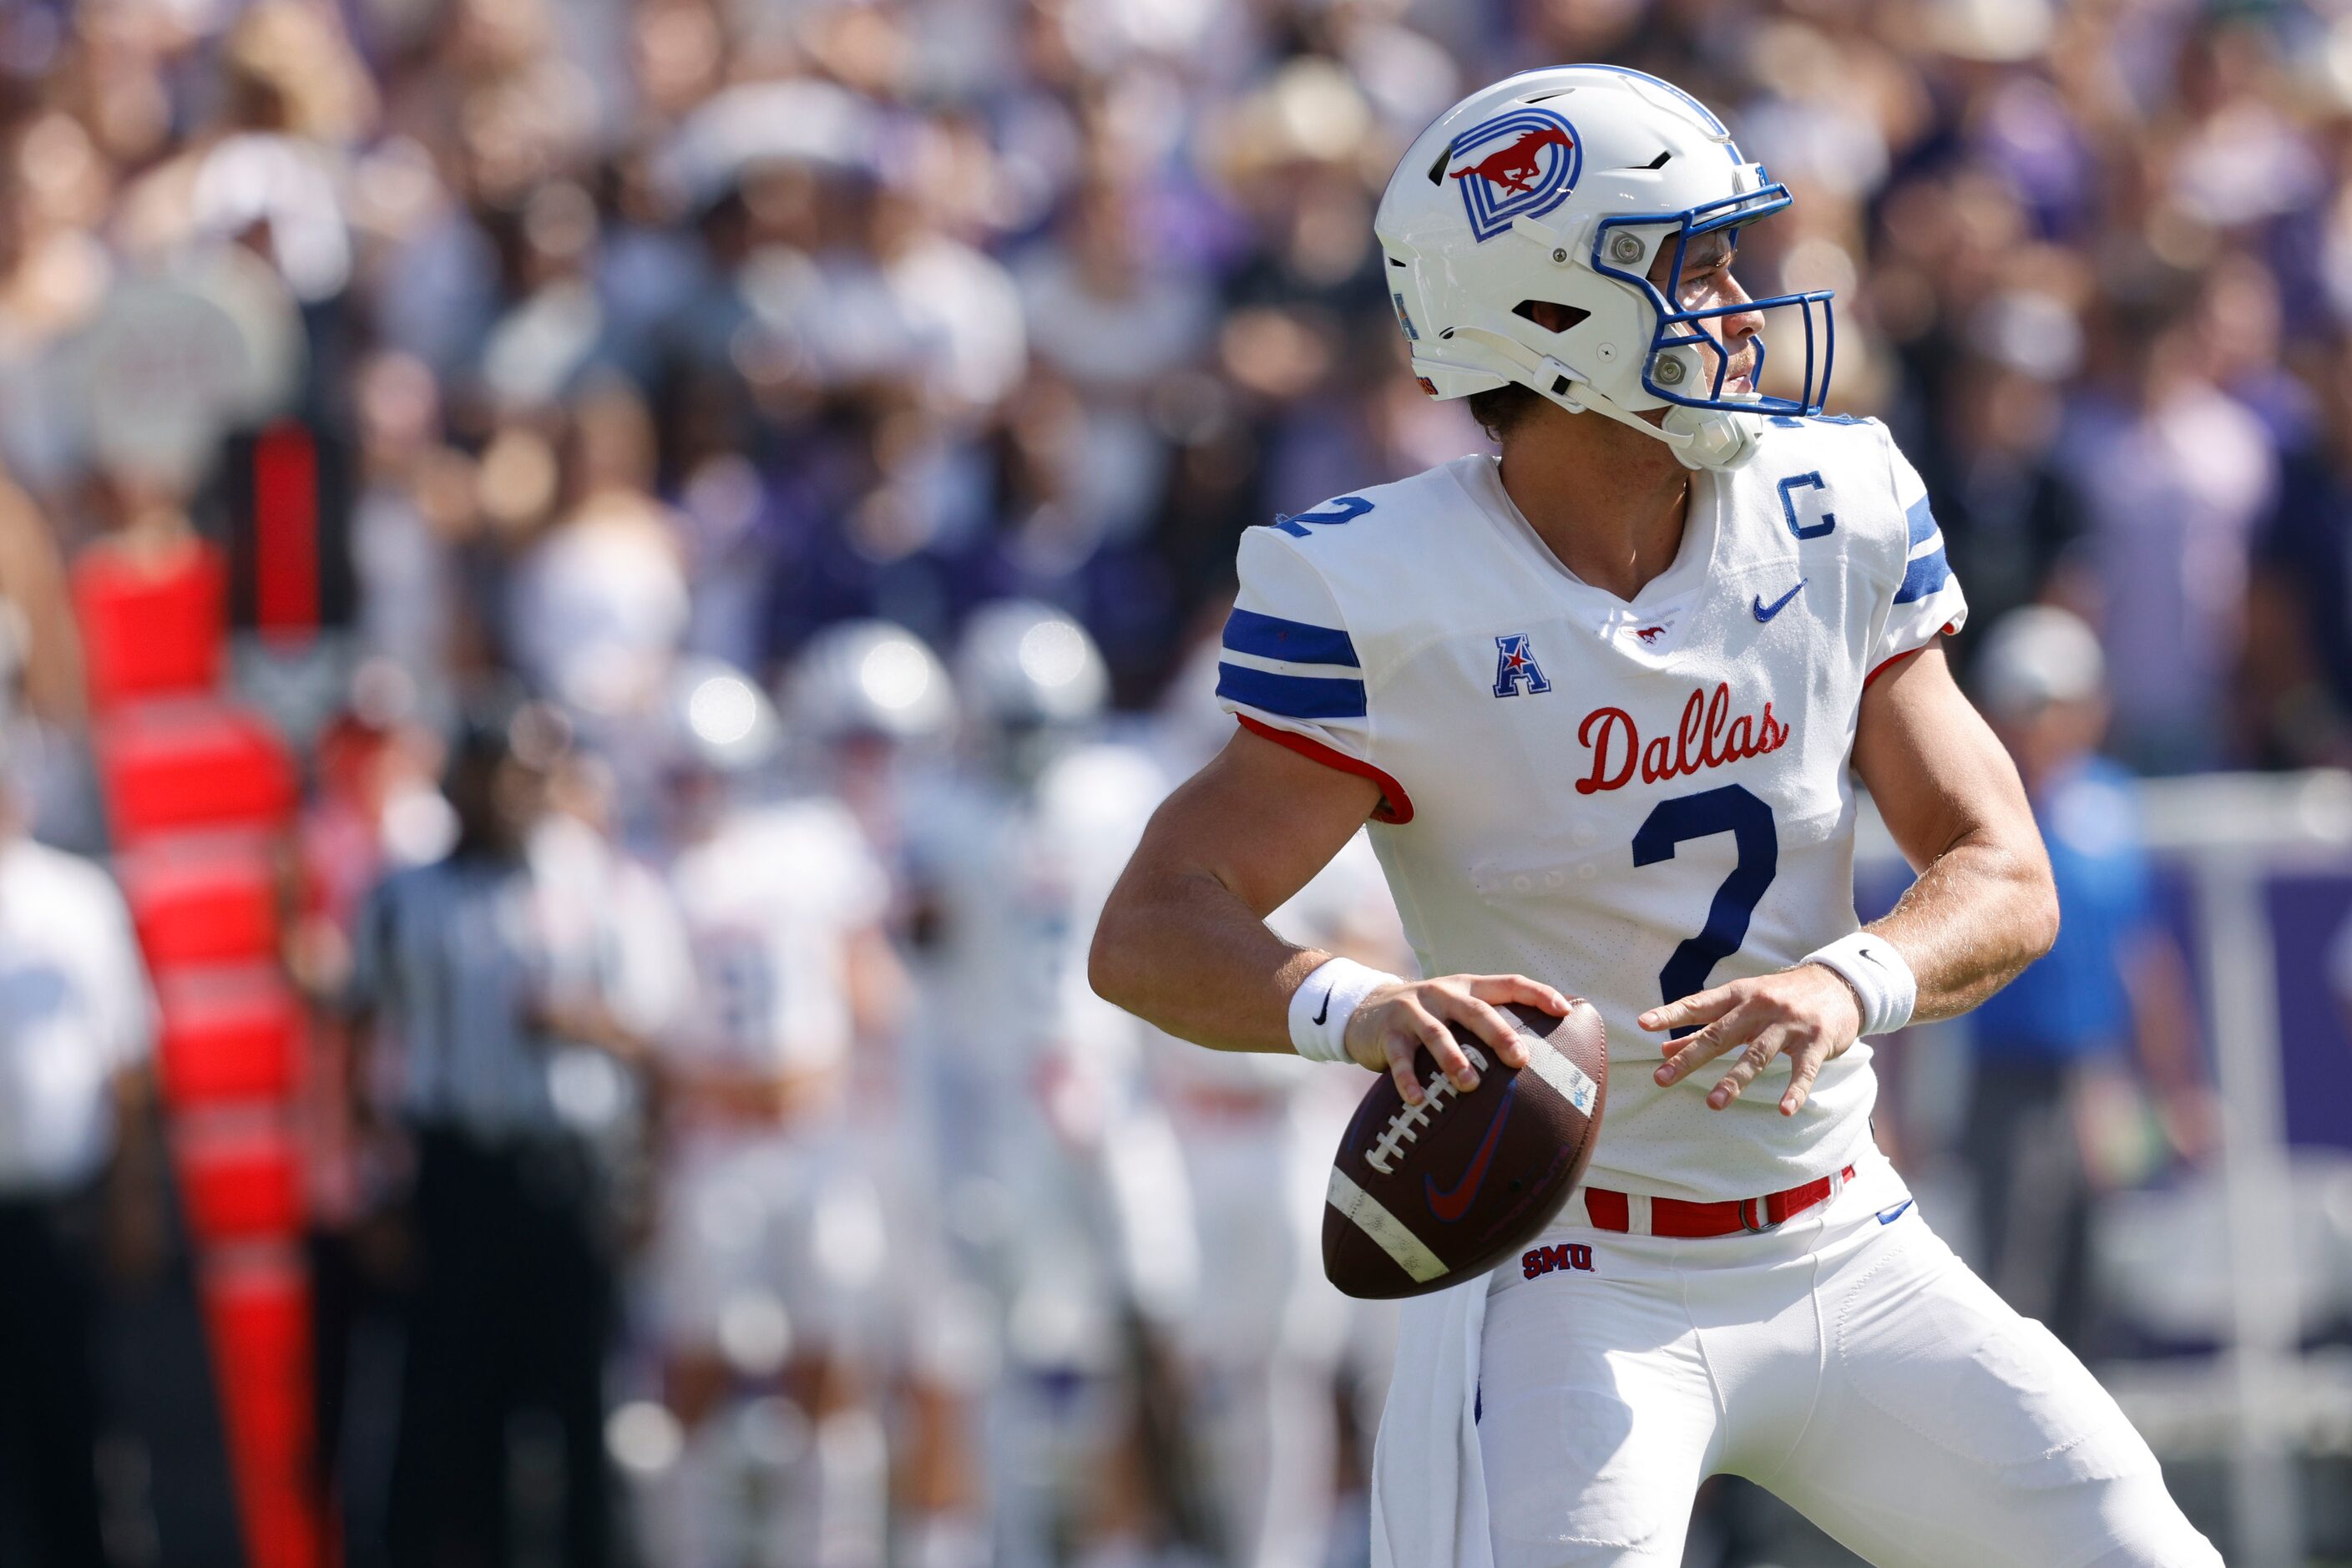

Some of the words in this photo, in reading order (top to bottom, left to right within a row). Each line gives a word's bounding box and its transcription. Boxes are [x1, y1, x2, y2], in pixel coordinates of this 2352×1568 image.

[1270, 496, 1375, 538] 2
[1777, 471, 1835, 540] C
[1493, 633, 1551, 698] A
[1576, 681, 1790, 795] Dallas
[1632, 783, 1778, 1041] 2
[1522, 1243, 1592, 1280] SMU
